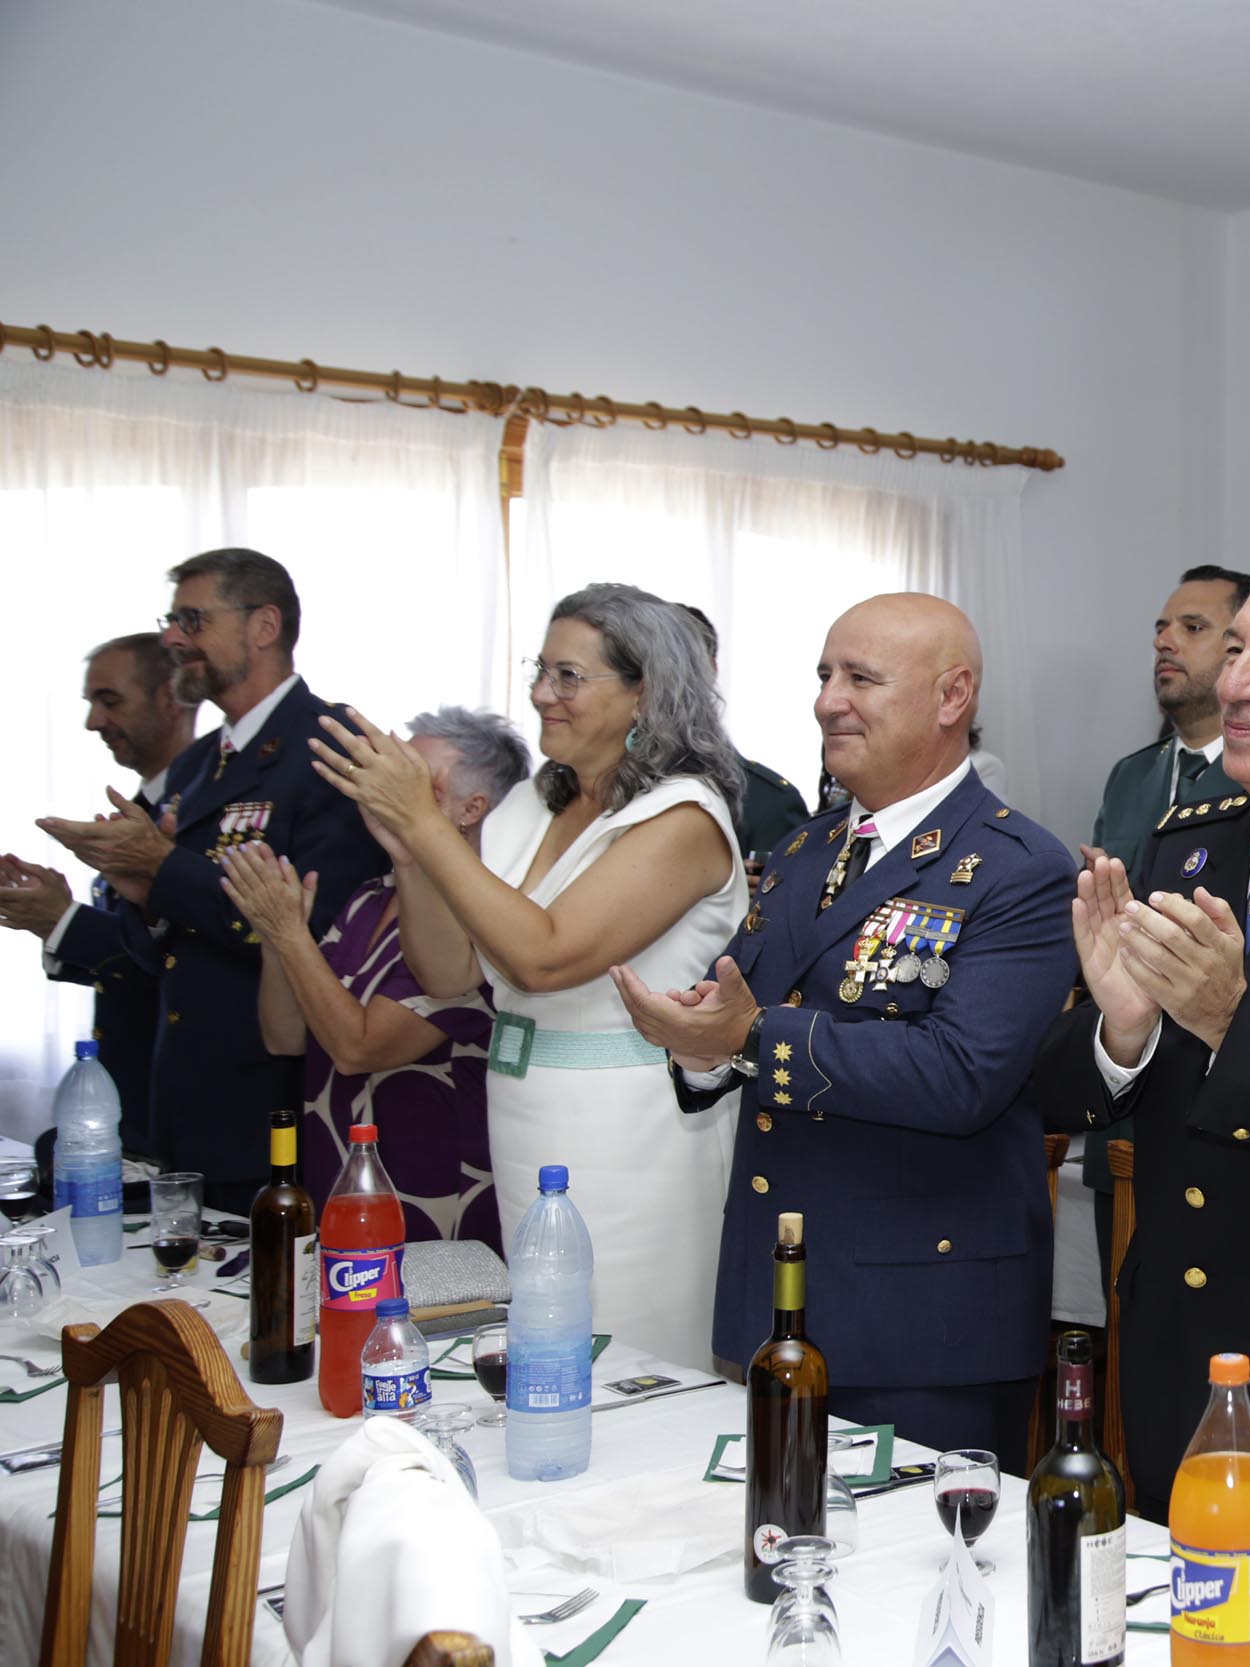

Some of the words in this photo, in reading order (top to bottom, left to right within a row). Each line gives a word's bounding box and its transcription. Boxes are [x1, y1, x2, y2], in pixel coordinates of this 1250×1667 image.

[329, 1261, 380, 1292] Clipper
[1065, 1379, 1081, 1397] H
[1057, 1398, 1091, 1410] HEBE
[1169, 1556, 1223, 1609] Clipper
